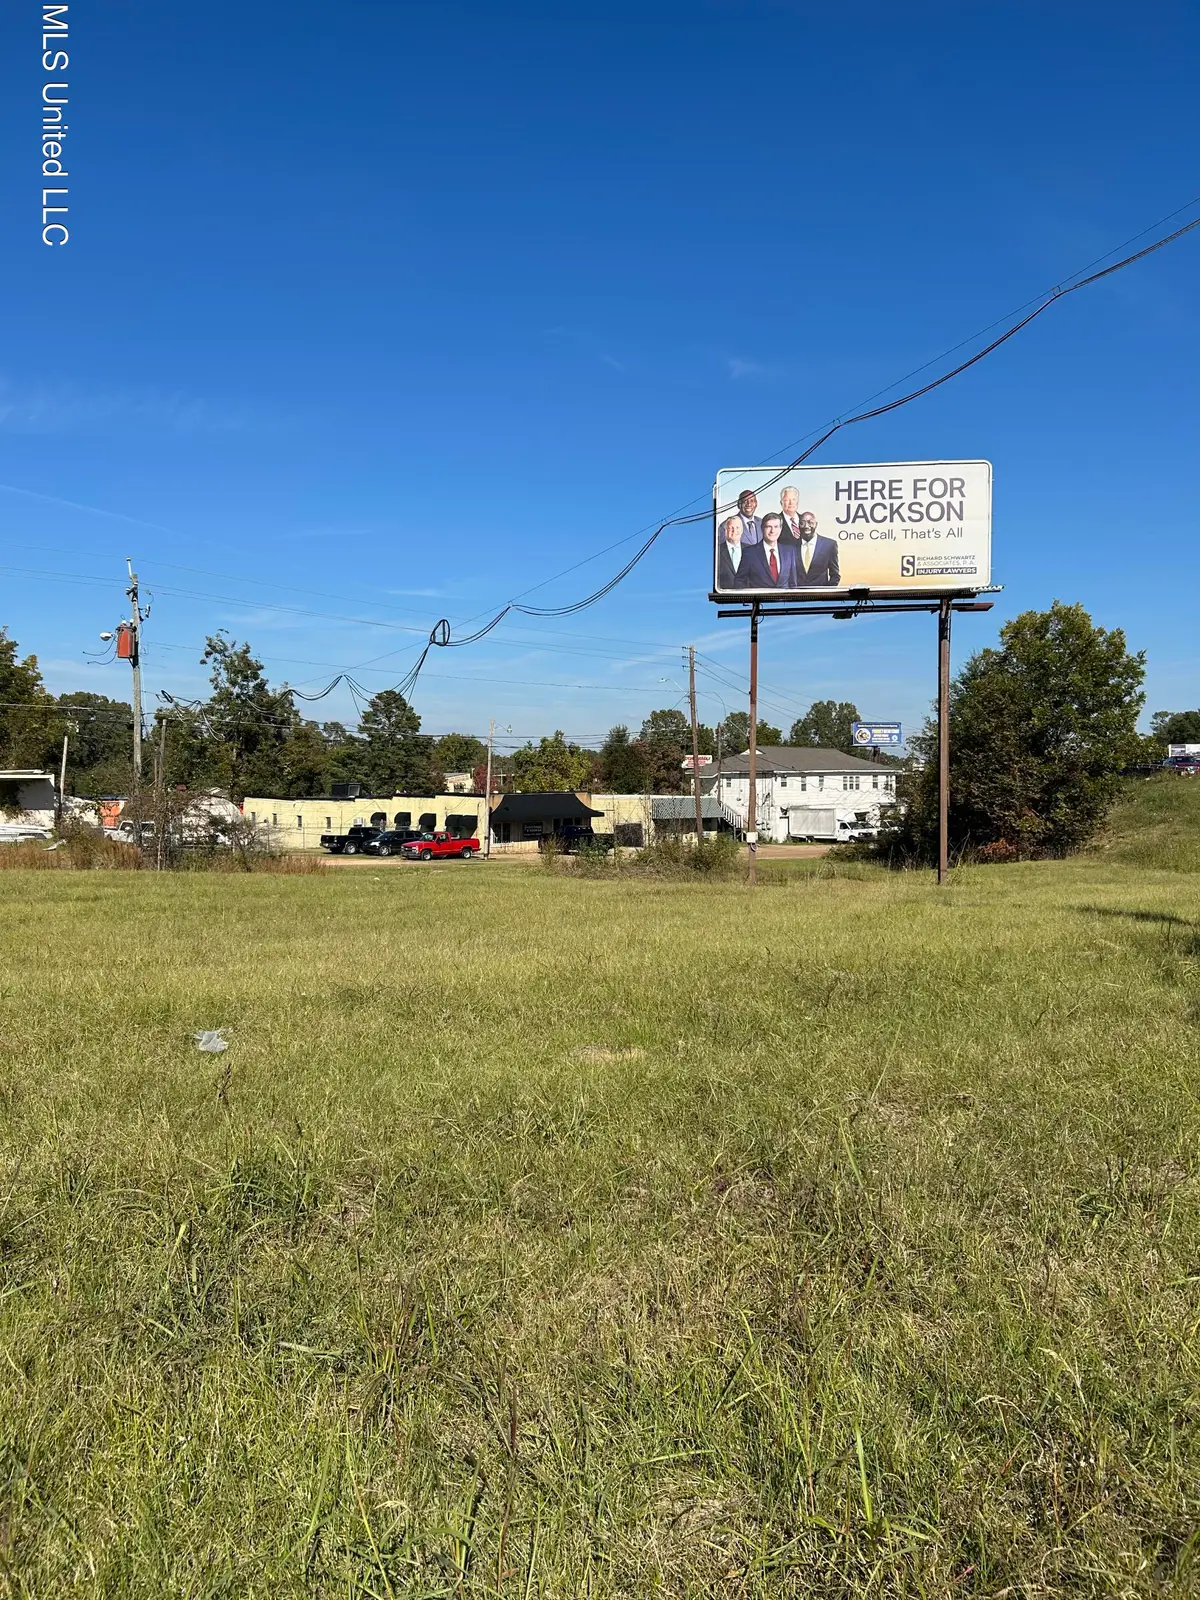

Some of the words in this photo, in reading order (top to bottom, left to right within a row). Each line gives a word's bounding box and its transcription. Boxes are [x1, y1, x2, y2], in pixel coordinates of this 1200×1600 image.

[835, 479, 903, 501] HERE
[913, 477, 966, 499] FOR
[835, 500, 964, 524] JACKSON
[838, 530, 864, 541] One
[869, 529, 897, 541] Call,
[901, 527, 941, 539] That's
[946, 527, 963, 538] All
[902, 556, 914, 576] S
